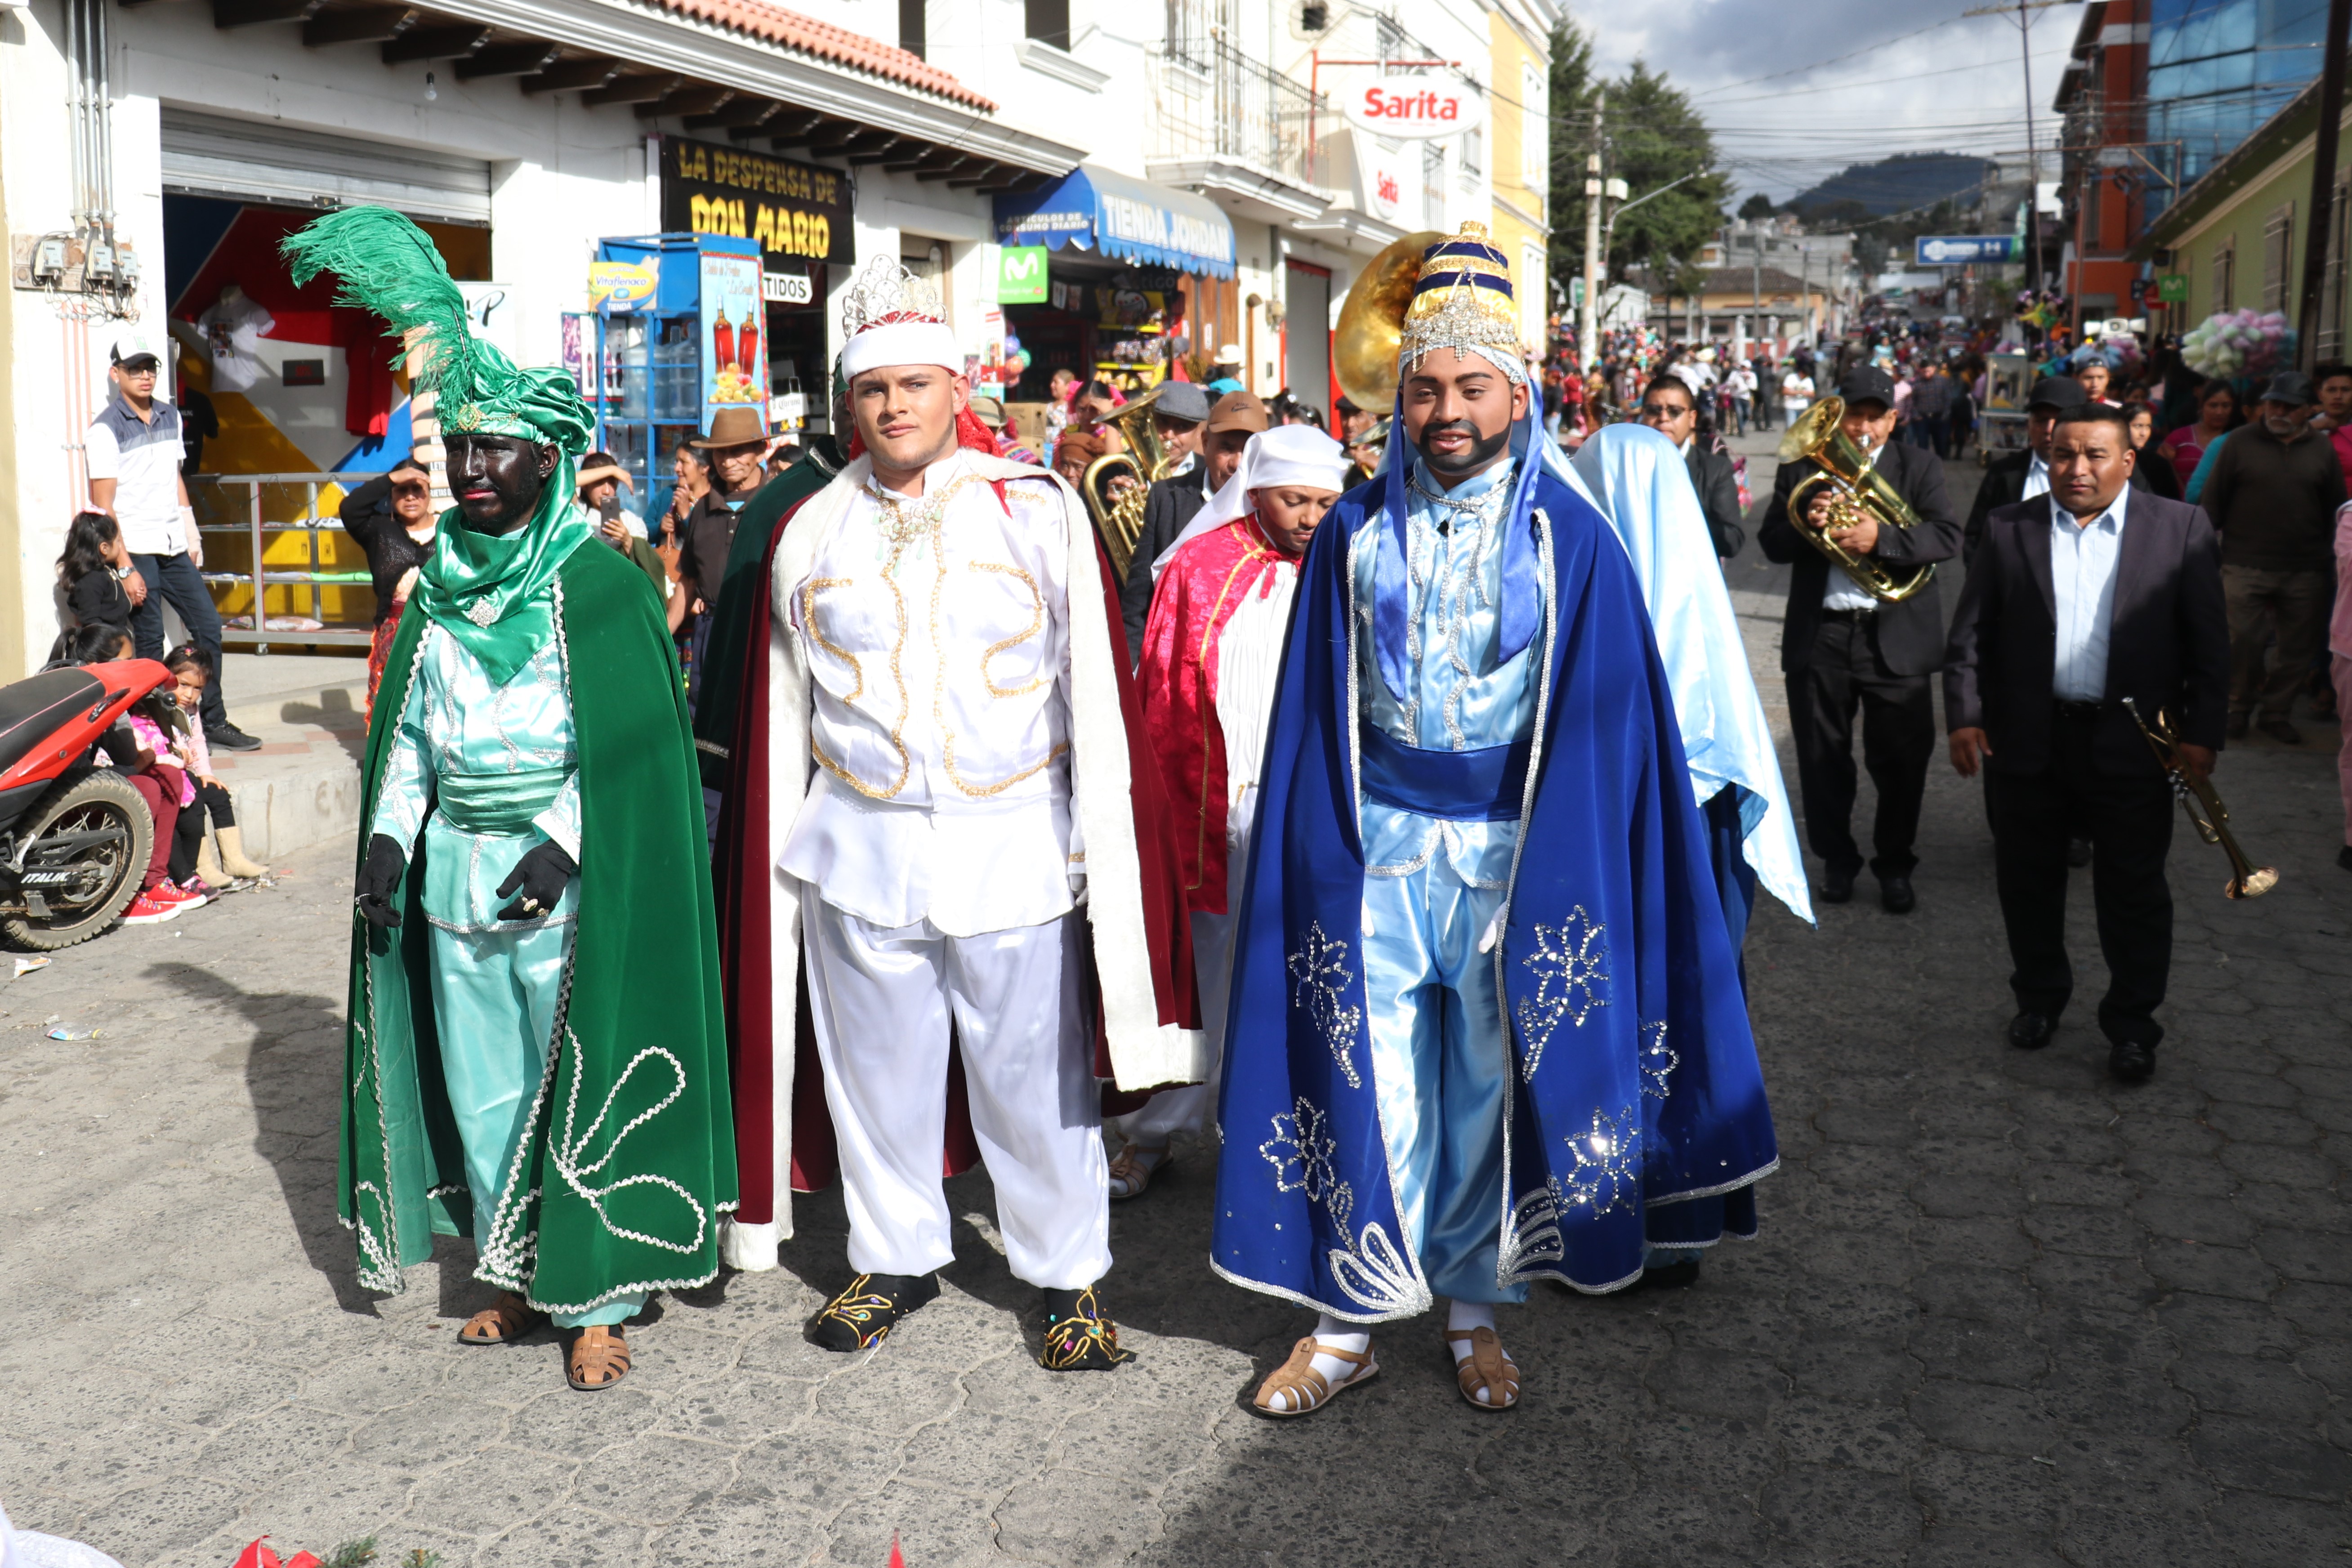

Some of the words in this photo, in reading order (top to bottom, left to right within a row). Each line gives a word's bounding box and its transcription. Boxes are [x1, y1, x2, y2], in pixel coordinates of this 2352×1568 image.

[1364, 88, 1457, 120] Sarita
[679, 143, 708, 181] LA
[713, 149, 811, 201] DESPENSA
[815, 171, 837, 205] DE
[1378, 170, 1398, 204] Sarita
[691, 193, 747, 238] DON
[753, 202, 830, 259] MARIO
[999, 223, 1049, 232] CONSUMO
[1052, 221, 1089, 230] DIARIO
[1102, 192, 1169, 250] TIENDA
[1170, 213, 1231, 263] JORDAN
[596, 275, 647, 288] Vitaflenaco
[607, 303, 632, 311] TIENDA
[778, 398, 800, 410] Corona
